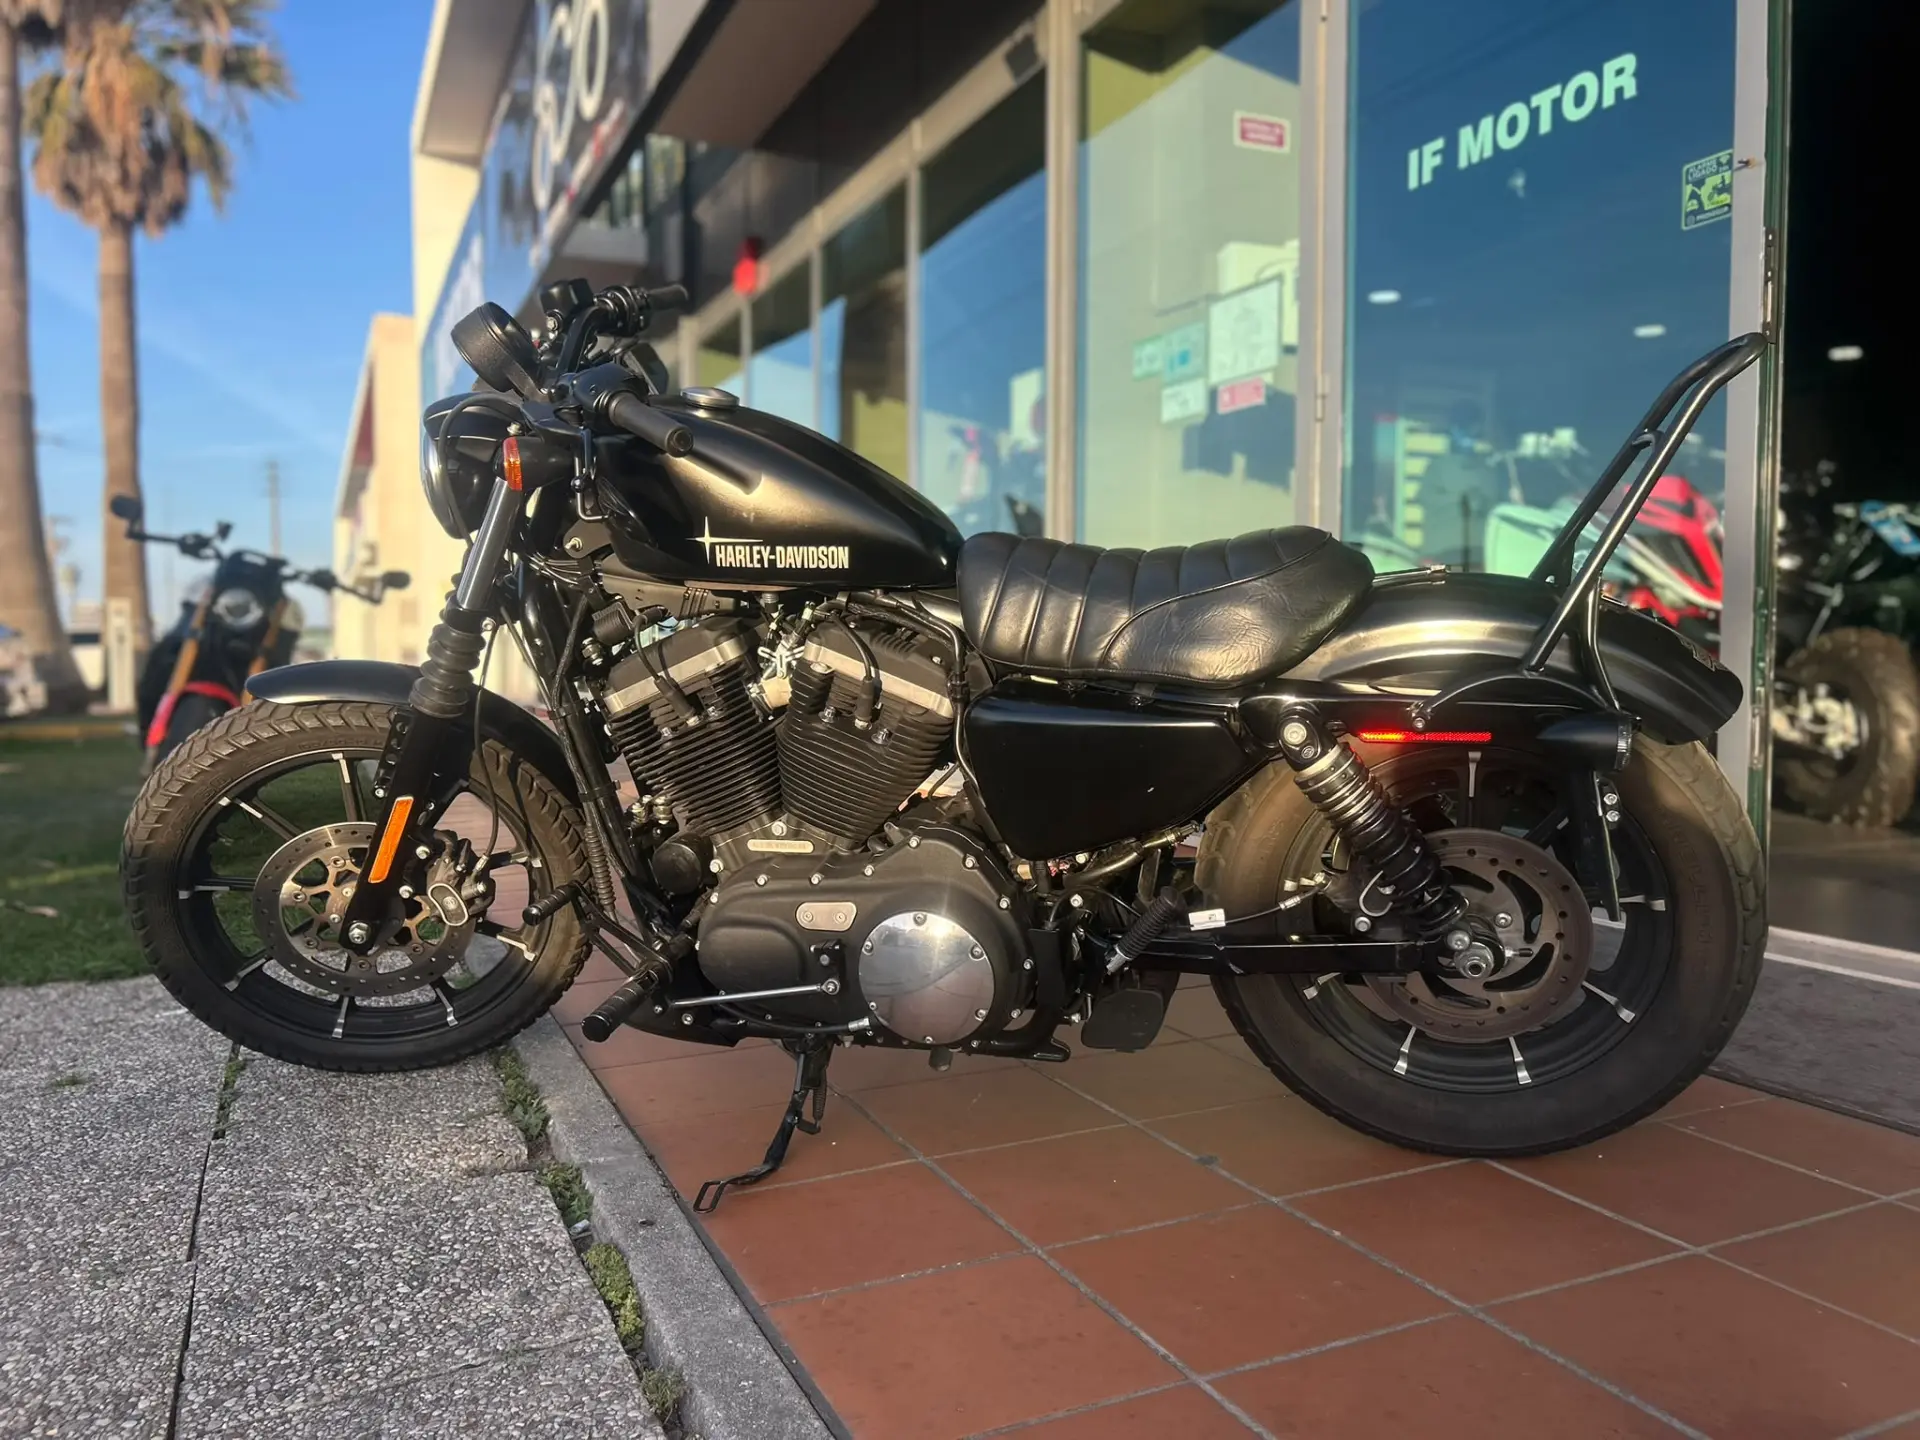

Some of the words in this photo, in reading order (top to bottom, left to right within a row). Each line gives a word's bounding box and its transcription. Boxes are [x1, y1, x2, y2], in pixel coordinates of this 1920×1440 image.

[1407, 136, 1446, 191] IF
[1457, 52, 1638, 170] MOTOR
[1688, 164, 1717, 181] LIGADO
[715, 545, 849, 569] HARLEY-DAVIDSON
